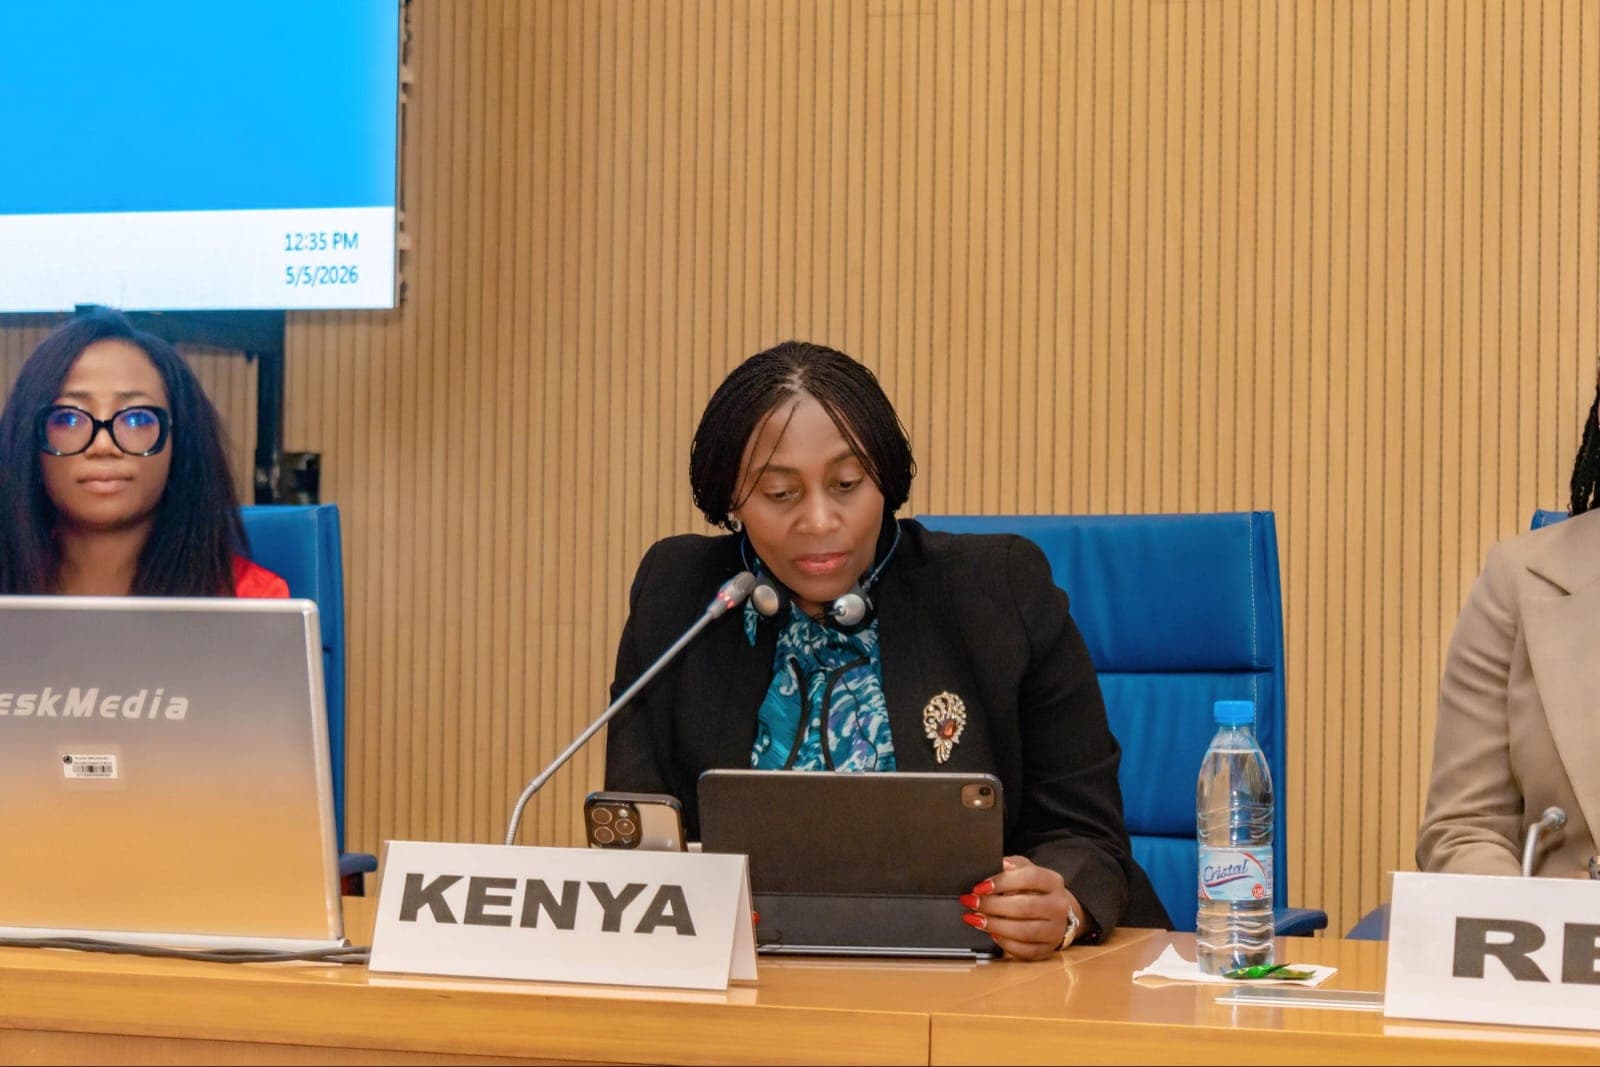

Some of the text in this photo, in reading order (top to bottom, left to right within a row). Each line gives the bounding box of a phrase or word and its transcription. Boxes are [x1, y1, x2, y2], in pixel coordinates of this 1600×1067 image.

[285, 232, 359, 251] 12:35 PM
[285, 265, 359, 287] 5/5/2026
[399, 872, 697, 936] KENYA
